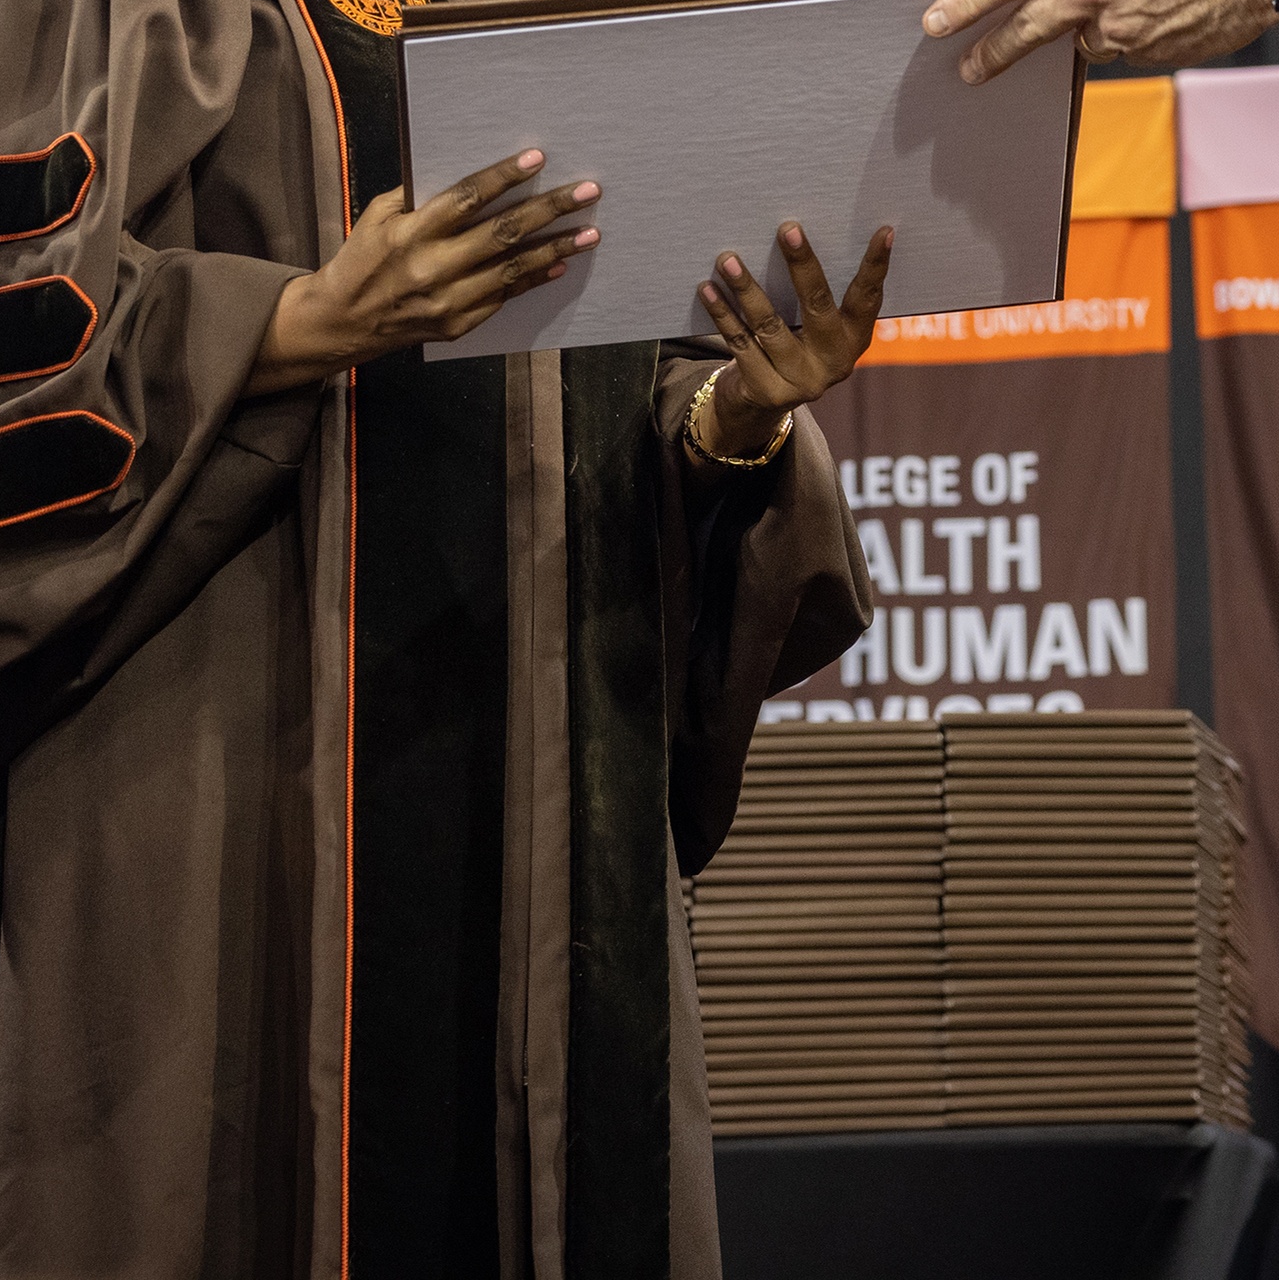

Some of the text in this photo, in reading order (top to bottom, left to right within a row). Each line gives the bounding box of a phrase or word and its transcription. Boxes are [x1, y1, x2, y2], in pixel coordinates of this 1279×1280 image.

[972, 297, 1151, 340] UNIVERSITY
[971, 451, 1039, 506] OF
[840, 596, 1150, 688] HUMAN
